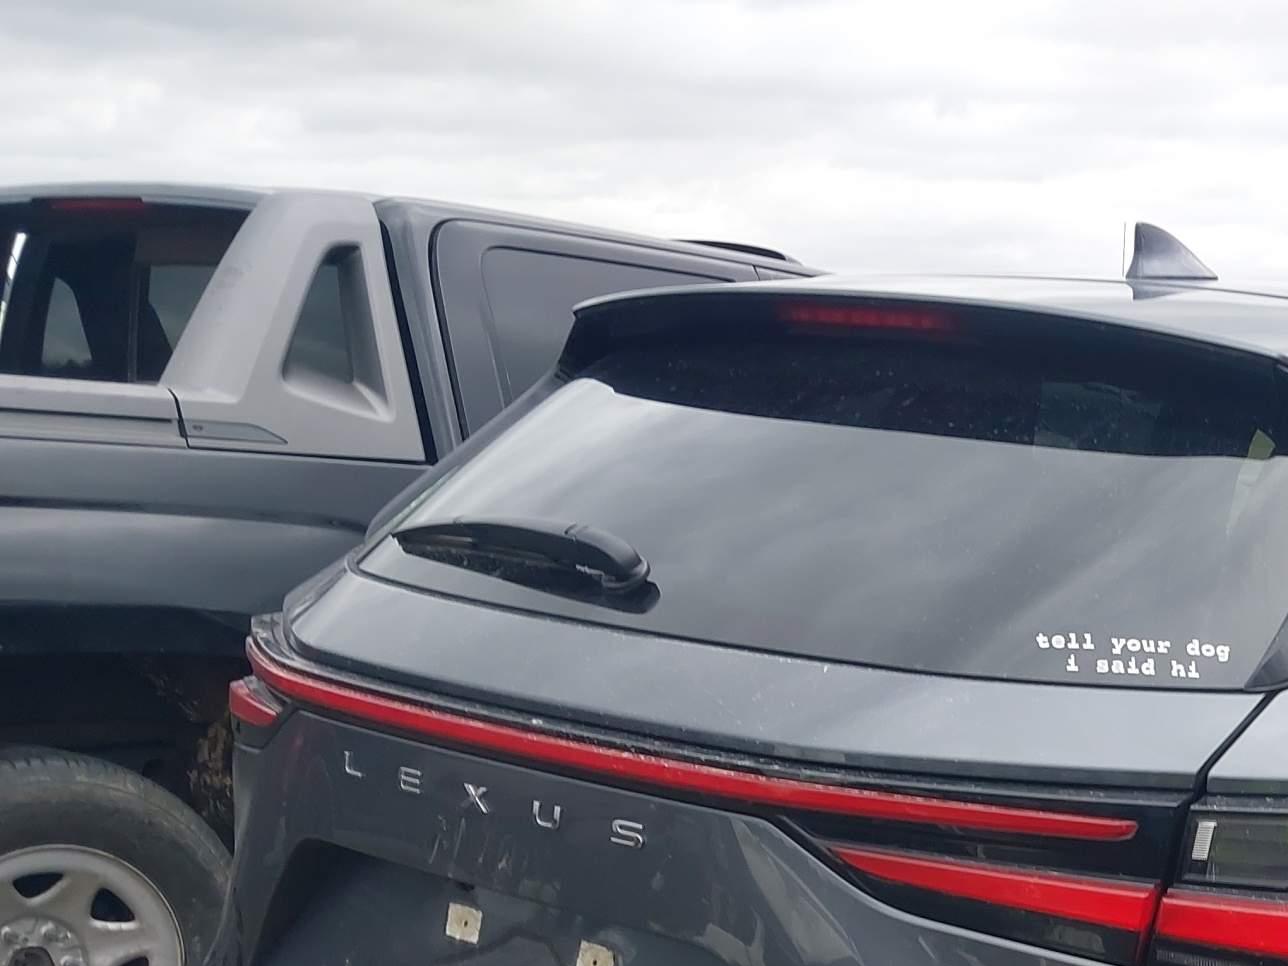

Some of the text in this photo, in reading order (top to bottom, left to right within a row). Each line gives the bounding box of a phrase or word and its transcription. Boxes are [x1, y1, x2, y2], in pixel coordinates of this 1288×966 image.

[1035, 632, 1231, 662] tell your dog
[1066, 653, 1201, 679] i said hi
[343, 750, 647, 849] LEXUS
